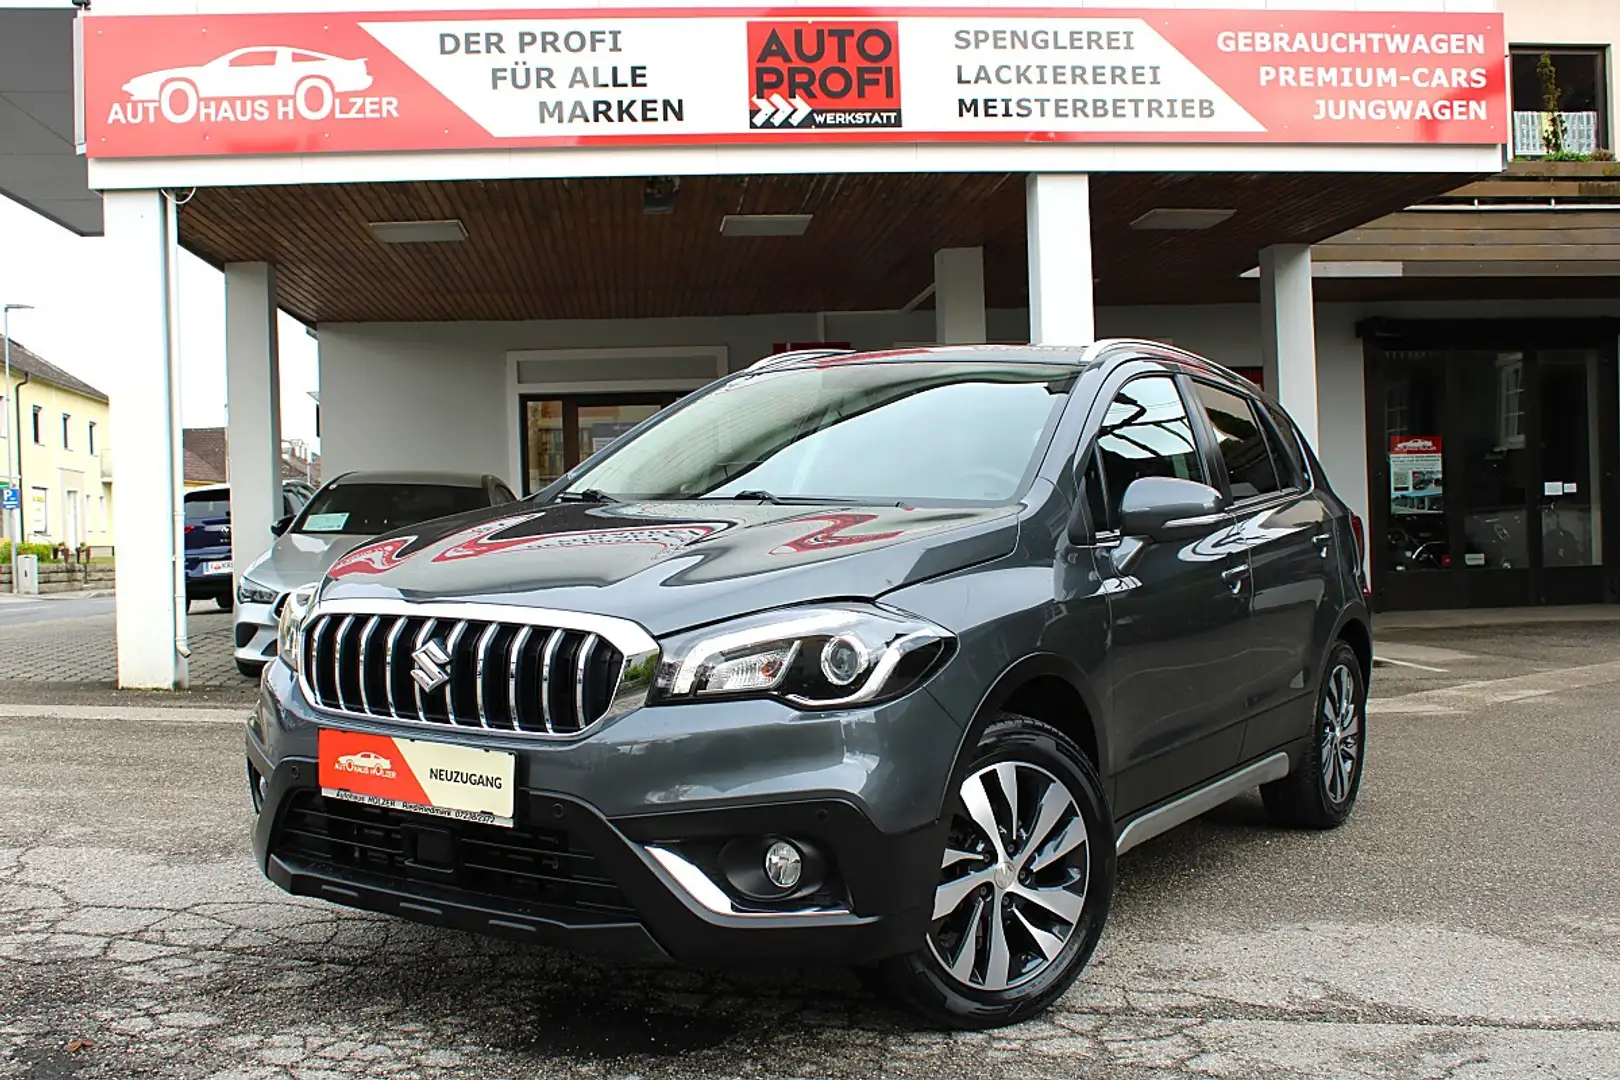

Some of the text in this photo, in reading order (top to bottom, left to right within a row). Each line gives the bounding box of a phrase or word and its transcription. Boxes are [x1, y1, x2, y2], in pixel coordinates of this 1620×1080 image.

[439, 30, 623, 55] DER PROFI
[756, 27, 892, 63] AUTO
[954, 29, 1135, 50] SPENGLEREI
[1216, 31, 1485, 54] GEBRAUCHTWAGEN
[491, 61, 648, 90] FÜR ALLE
[755, 66, 894, 99] PROFI
[957, 64, 1161, 85] LACKIEREREI
[1259, 65, 1487, 89] PREMIUM-CARS
[107, 77, 399, 124] AUTOHAUS HOLZER
[538, 98, 684, 124] MARKEN
[958, 98, 1215, 118] MEISTERBETRIEB
[1313, 99, 1487, 121] JUNGWAGEN
[813, 112, 897, 124] WERKSTATT
[429, 768, 502, 789] NEUZUGANG
